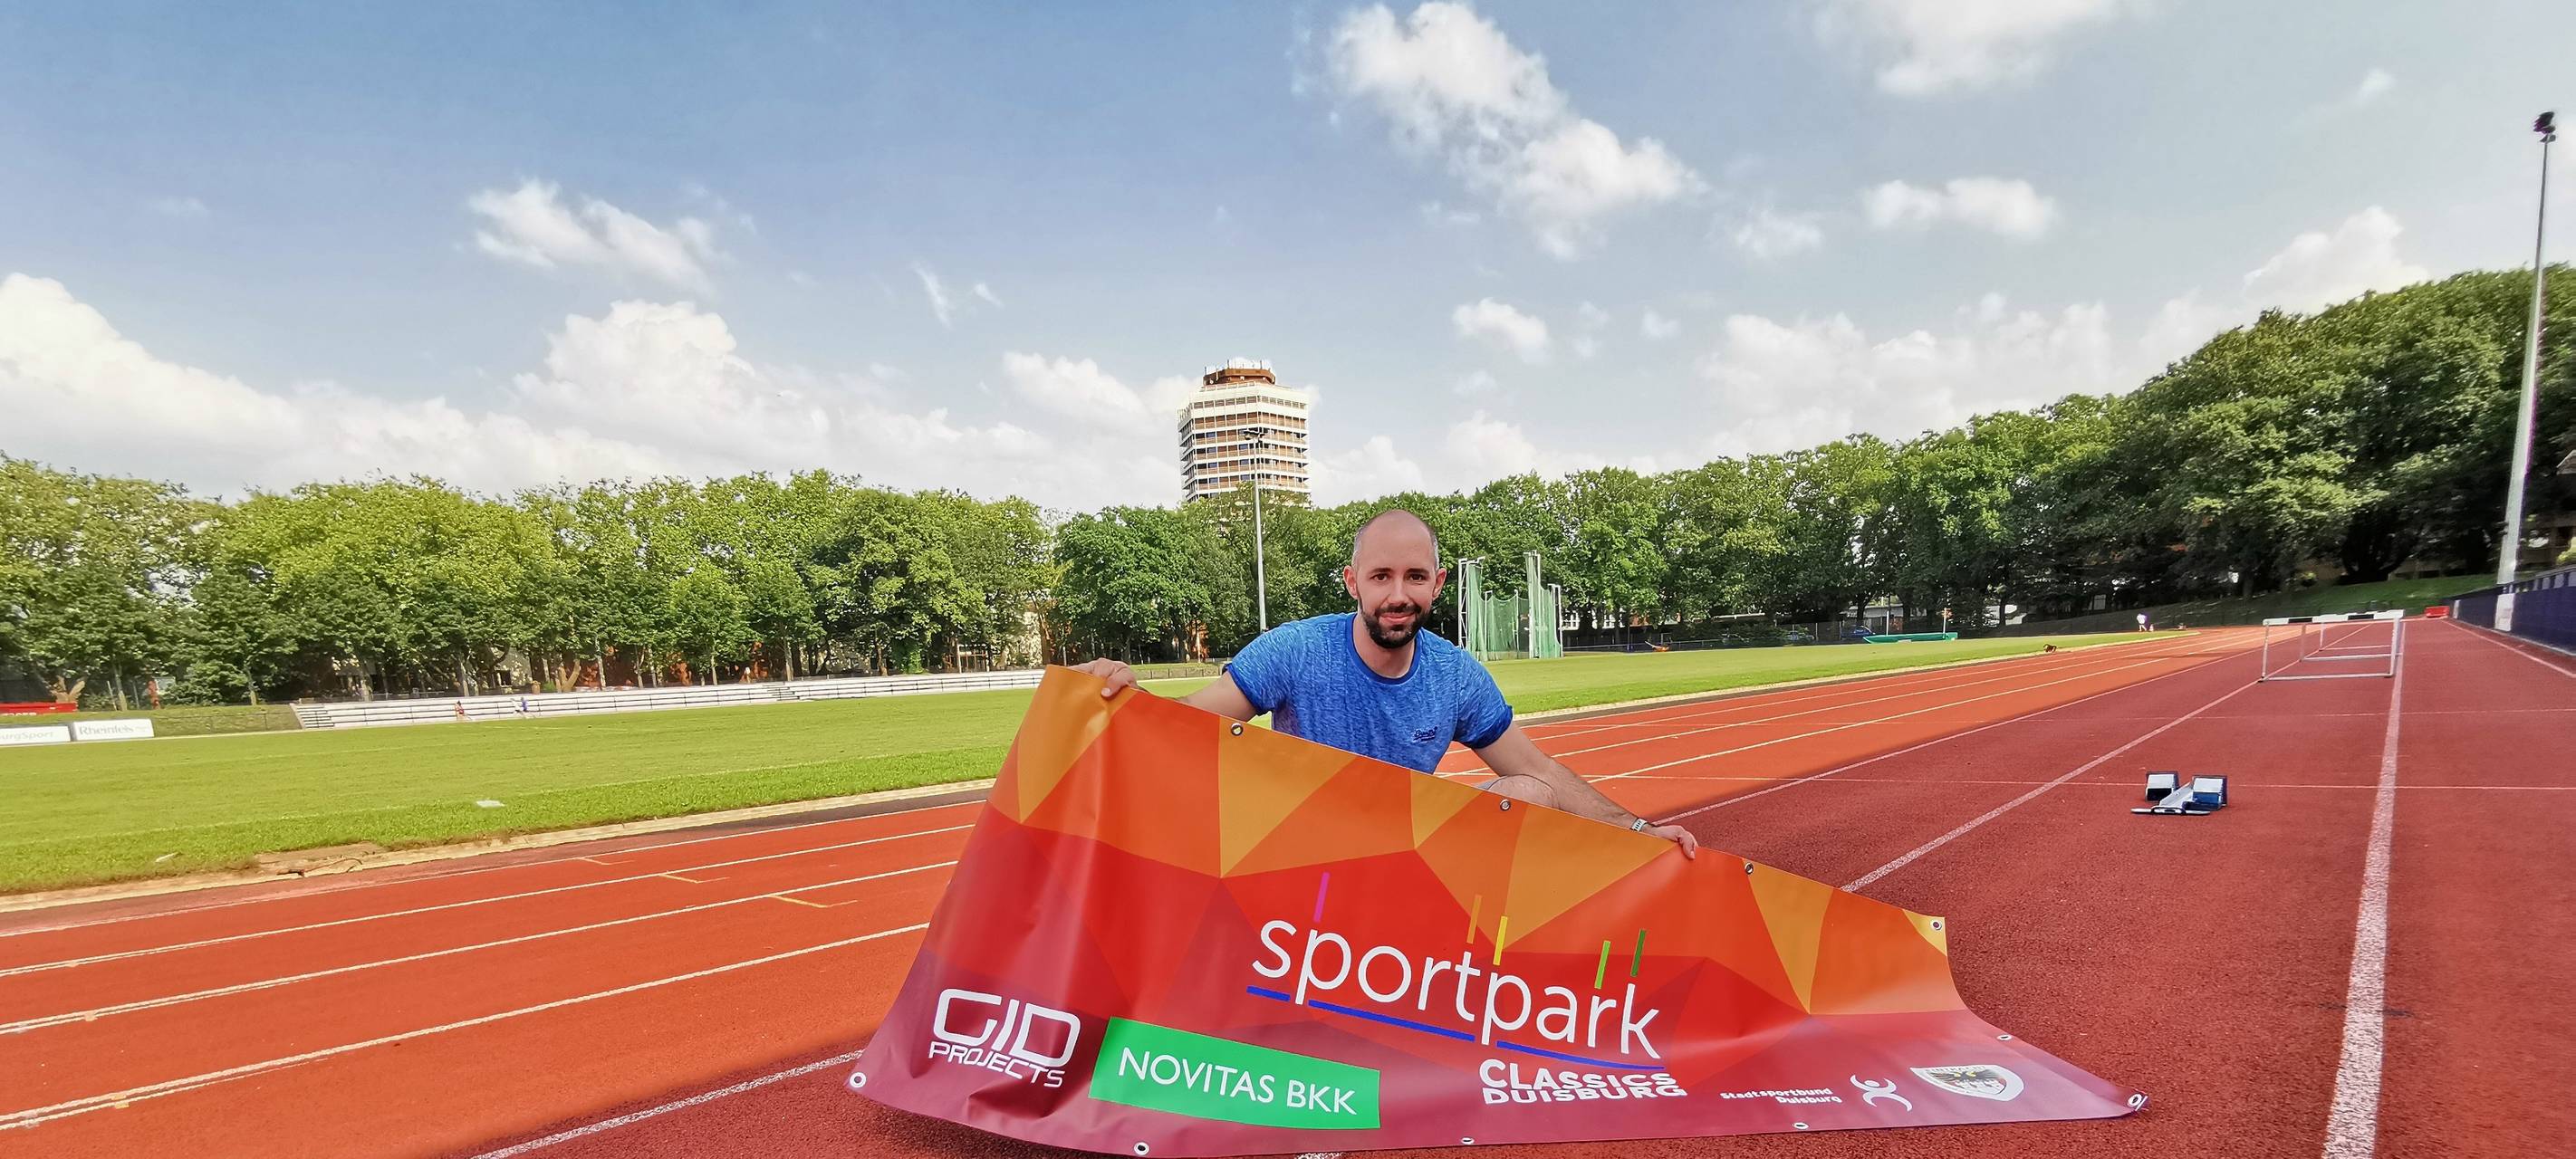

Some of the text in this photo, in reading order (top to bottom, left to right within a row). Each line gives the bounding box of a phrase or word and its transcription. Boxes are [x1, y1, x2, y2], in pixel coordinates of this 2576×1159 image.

[0, 731, 53, 742] urgSport
[1252, 919, 1661, 1059] sportpark
[928, 1040, 1066, 1087] PROJECTS
[1478, 1058, 1677, 1090] CLASSICS
[1118, 1047, 1358, 1116] NOVITAS BKK
[1719, 1087, 1833, 1099] Stadtsportbund
[1482, 1086, 1688, 1105] DUISBURG
[1774, 1096, 1842, 1104] Duisburg
